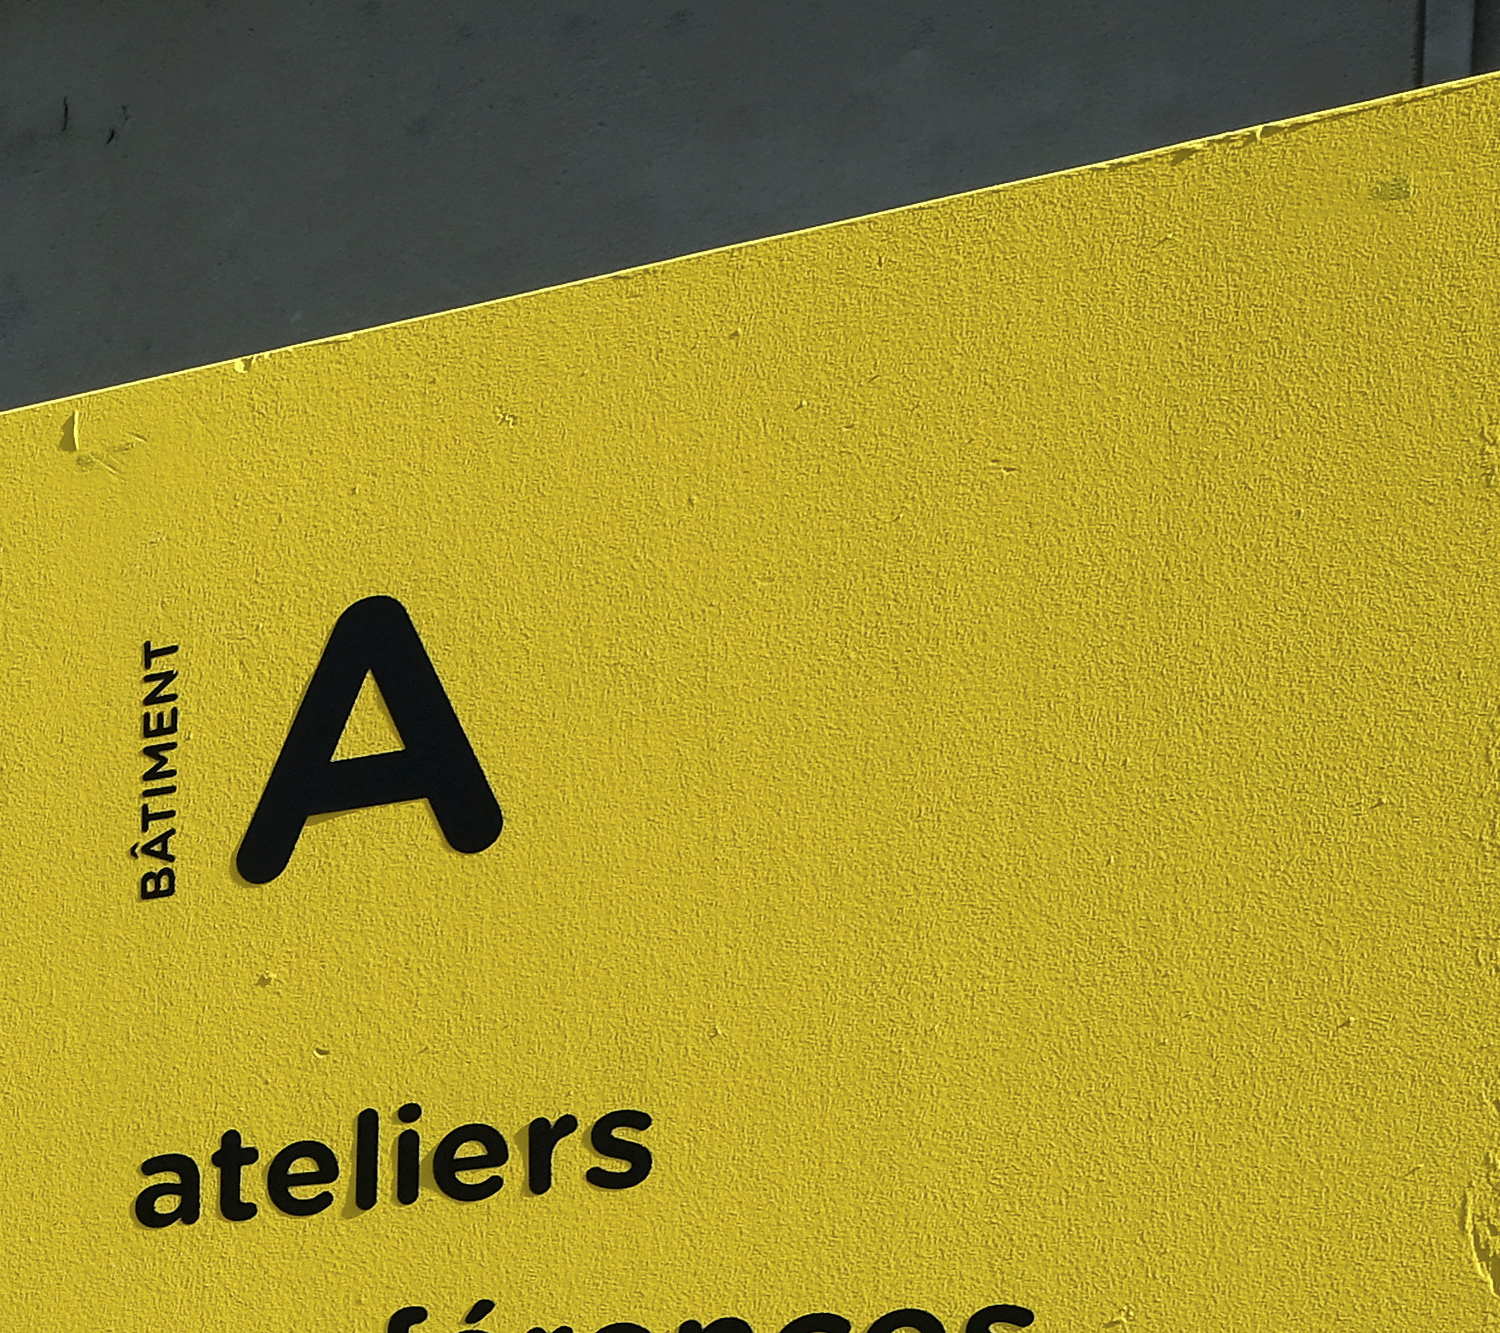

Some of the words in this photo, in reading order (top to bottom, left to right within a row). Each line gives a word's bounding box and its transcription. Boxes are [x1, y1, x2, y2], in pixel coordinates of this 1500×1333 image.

[131, 640, 179, 900] BÂTIMENT
[236, 595, 503, 884] A
[133, 1102, 653, 1229] ateliers
